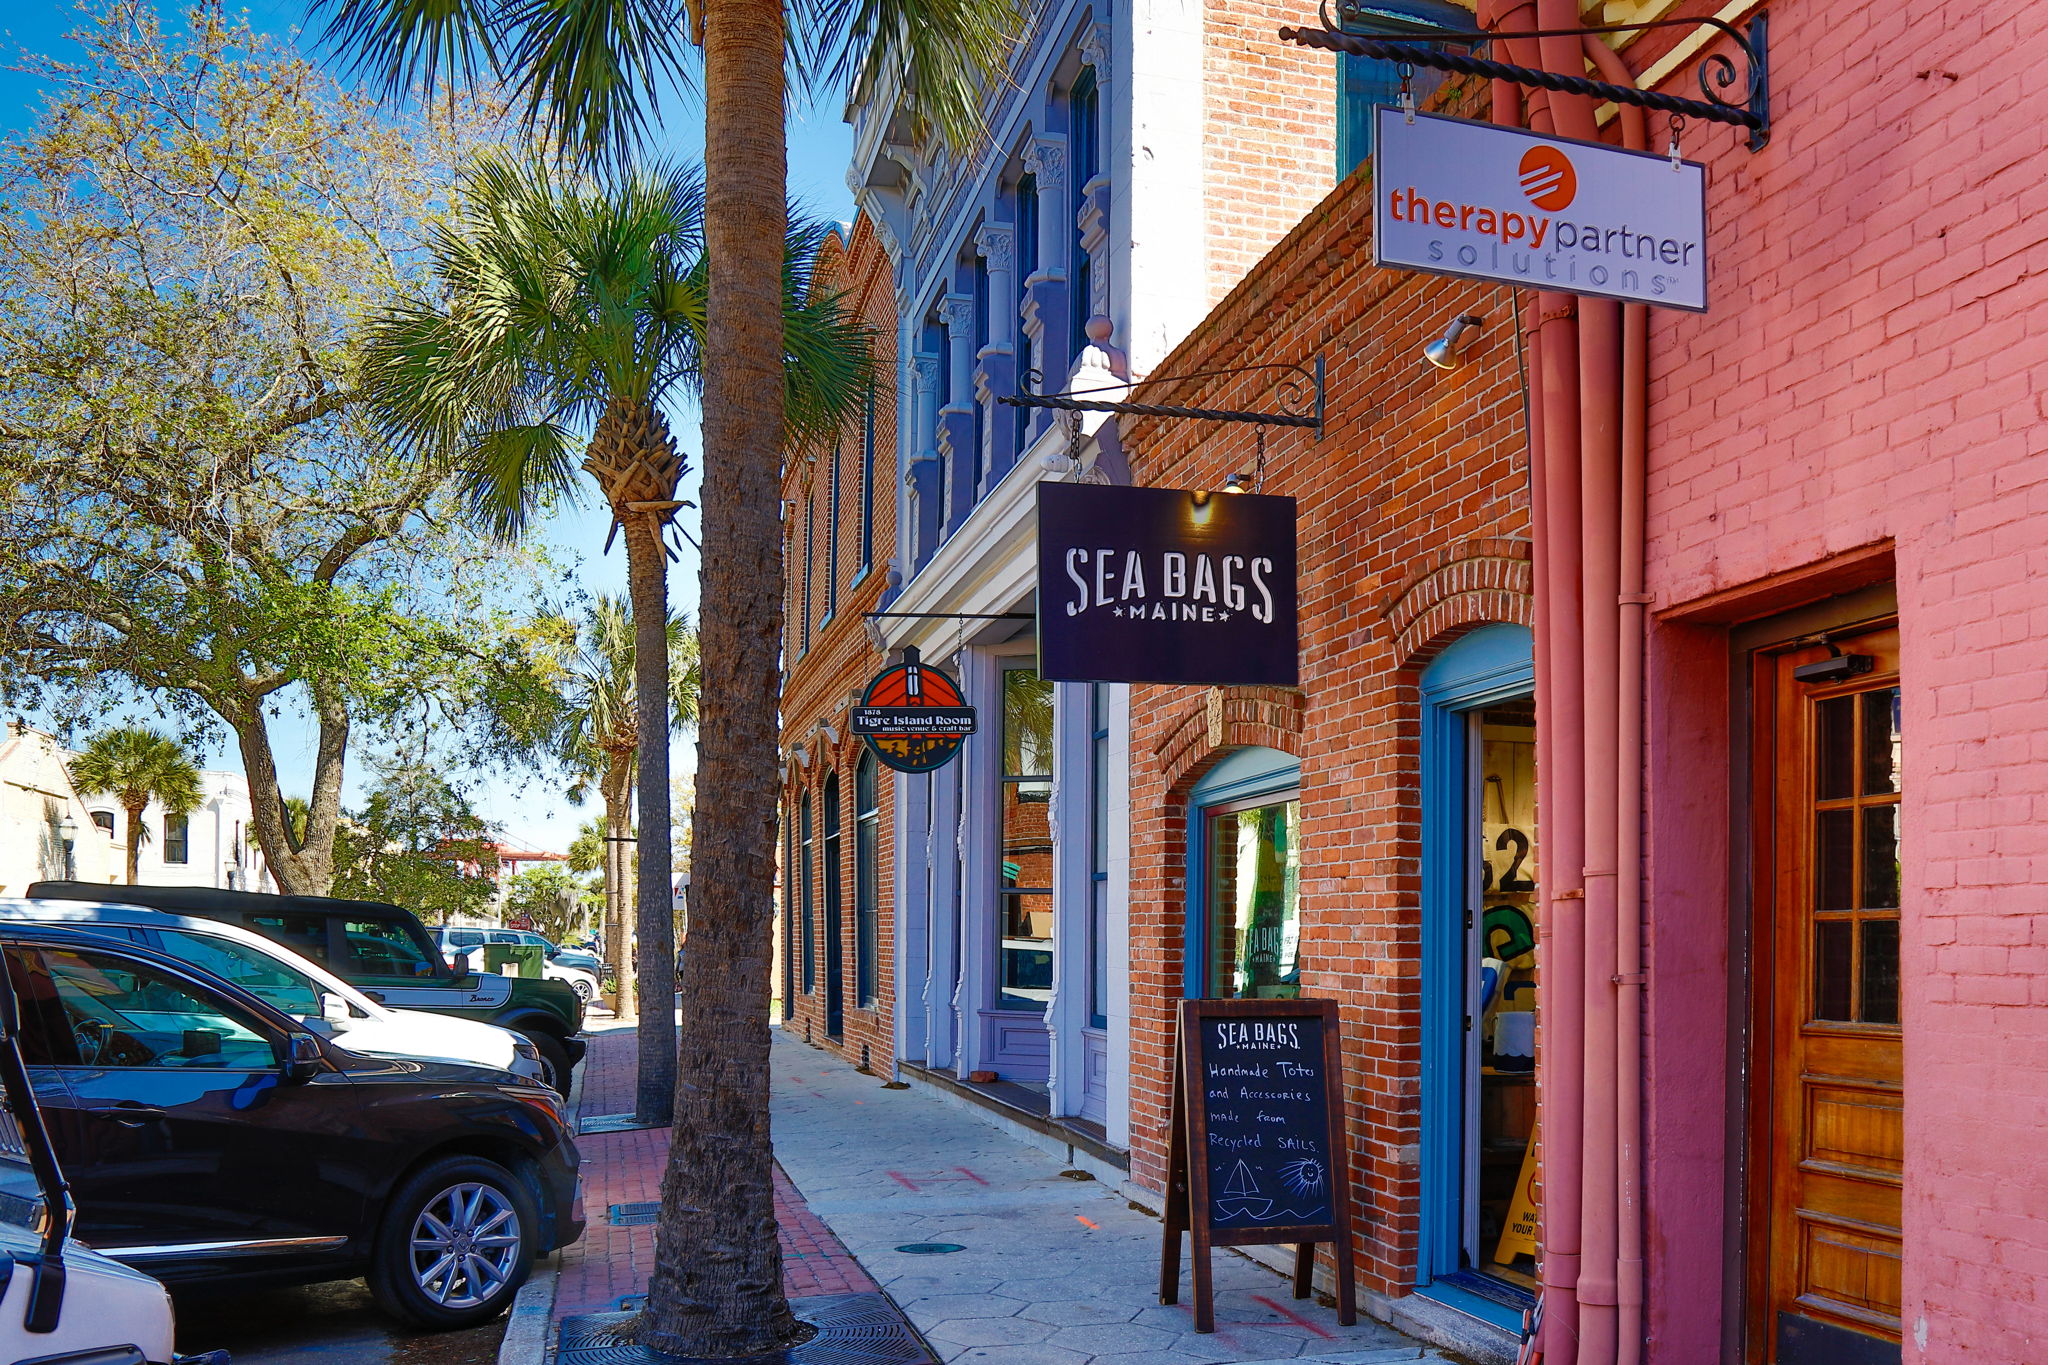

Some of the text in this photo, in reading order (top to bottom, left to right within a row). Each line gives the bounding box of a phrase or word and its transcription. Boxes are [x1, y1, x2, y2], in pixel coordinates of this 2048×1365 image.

[1066, 548, 1274, 624] SEA BAGS
[1129, 602, 1216, 623] MAINE
[857, 716, 972, 727] Tigre Island Room
[1217, 1023, 1298, 1049] SEA BAGS
[1242, 1042, 1275, 1050] MAINE
[1209, 1062, 1314, 1078] Handmade Totes
[1209, 1087, 1229, 1099] and
[1209, 1133, 1262, 1152] Recycled
[1512, 1222, 1533, 1235] YOUR
